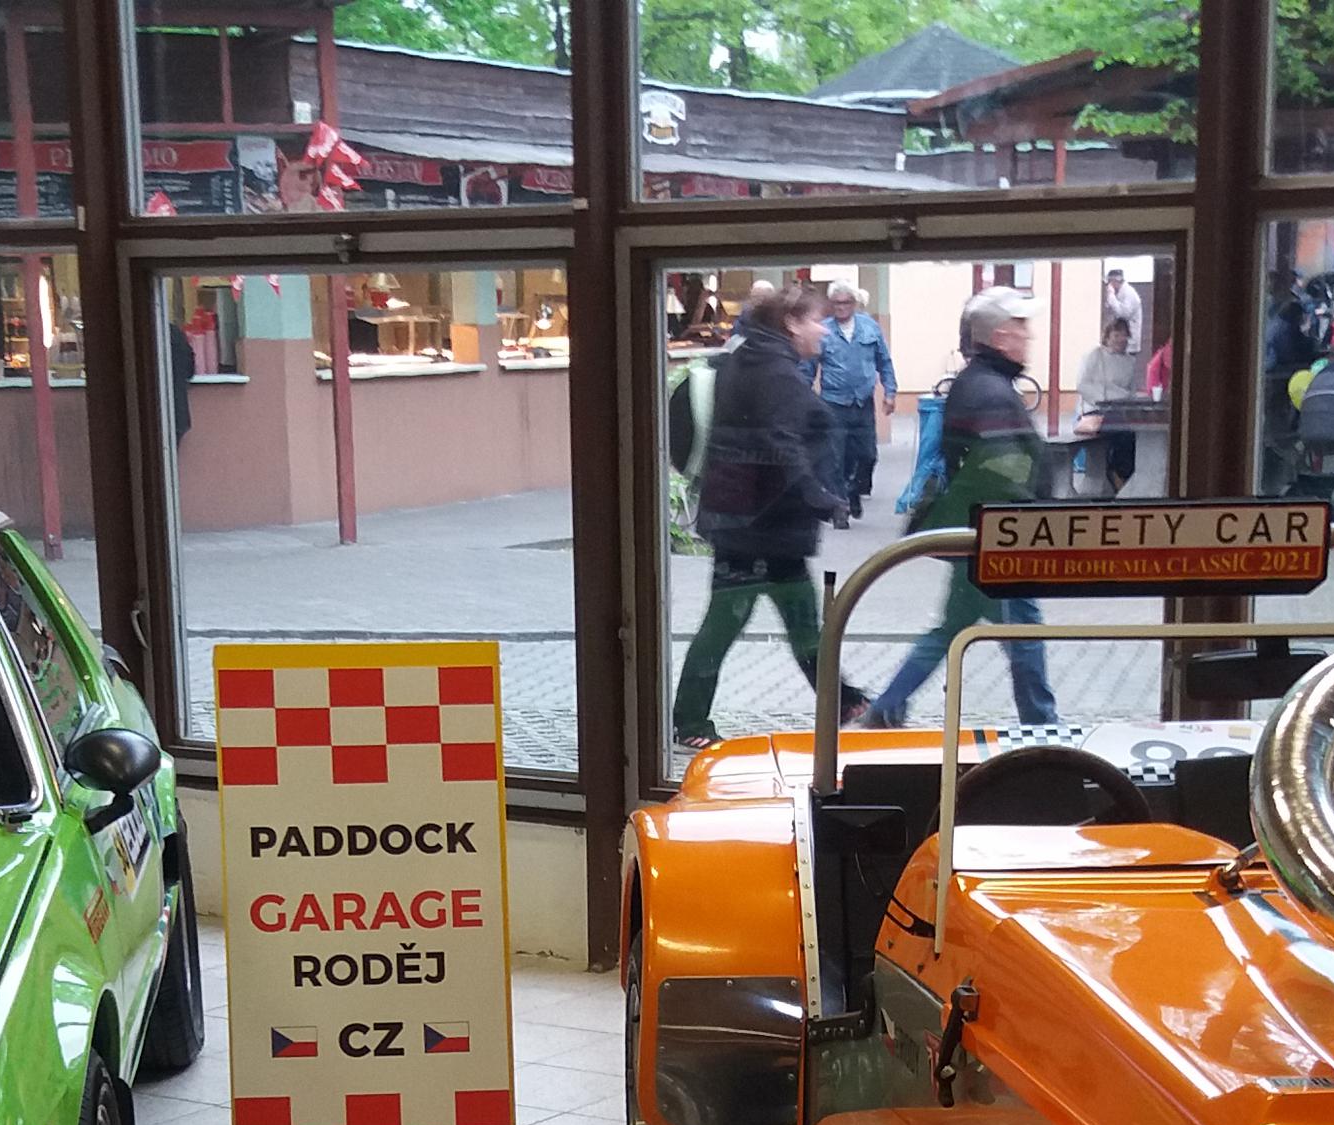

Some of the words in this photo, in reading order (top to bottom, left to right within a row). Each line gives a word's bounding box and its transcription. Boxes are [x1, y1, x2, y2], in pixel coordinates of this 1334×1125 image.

[996, 513, 1186, 547] SAFETY
[1217, 512, 1309, 544] CAR
[988, 555, 1058, 576] SOUTH
[1064, 555, 1161, 575] BOHEMIA
[1167, 552, 1252, 573] CLASSIC
[1261, 551, 1311, 571] 2021
[249, 822, 477, 858] PADDOCK
[249, 889, 484, 933] GARAGE
[293, 942, 446, 987] RODĚJ
[338, 1022, 405, 1058] CZ
